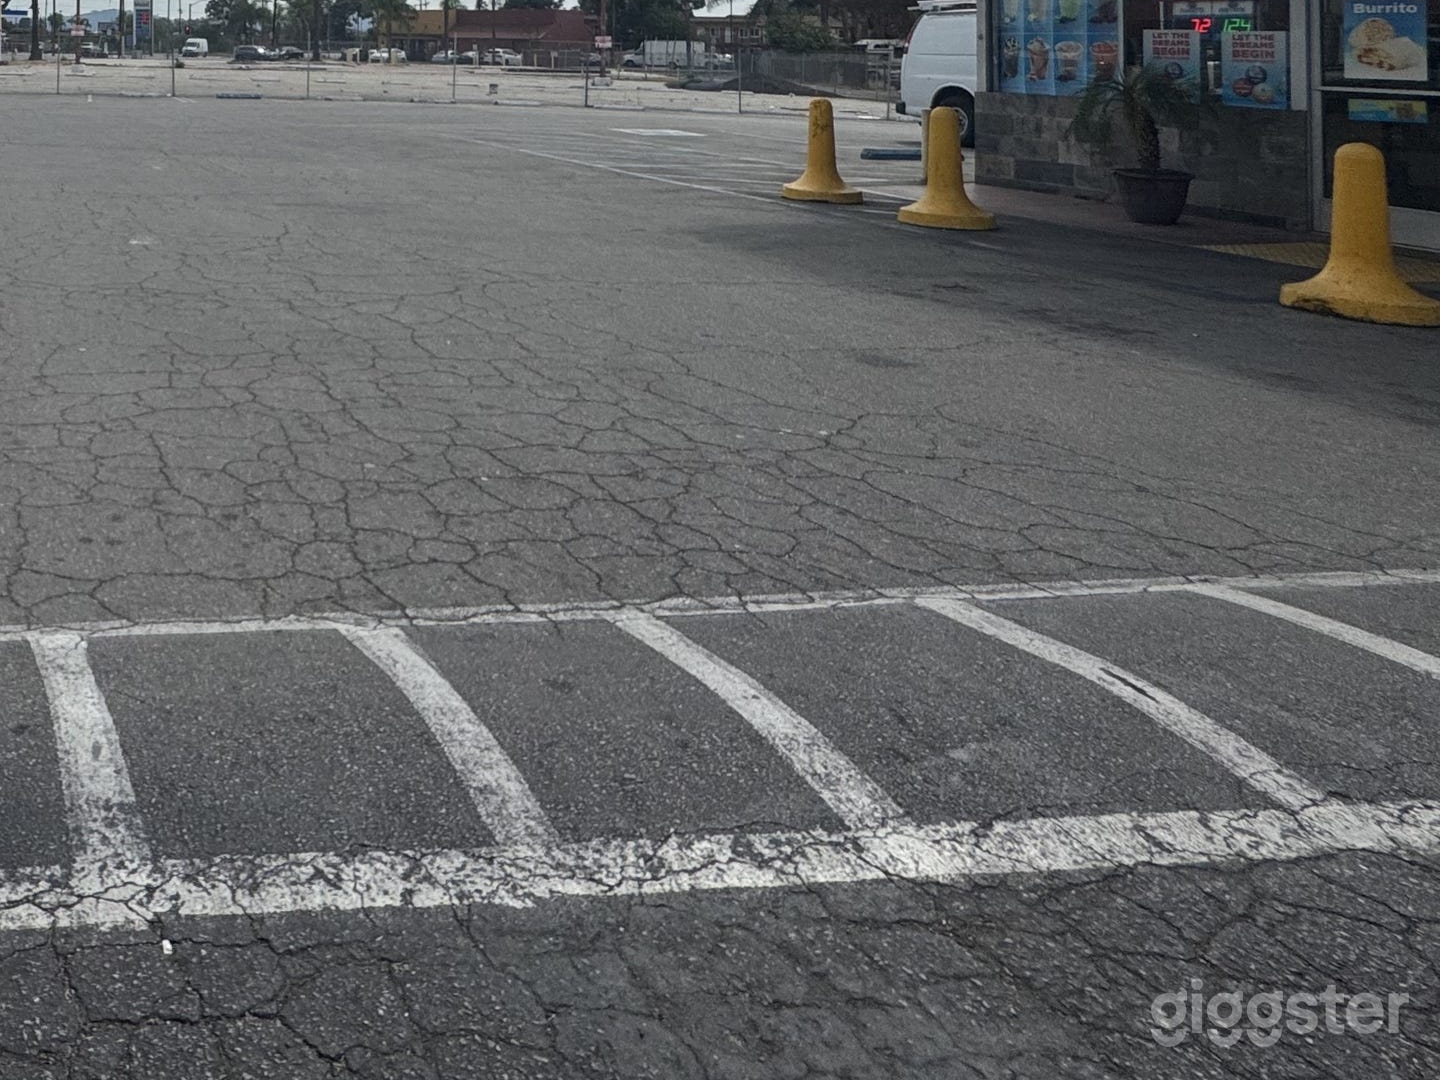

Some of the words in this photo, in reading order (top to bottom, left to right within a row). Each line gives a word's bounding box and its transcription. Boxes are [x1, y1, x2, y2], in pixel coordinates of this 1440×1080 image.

[1353, 2, 1418, 14] Burrito
[1191, 18, 1212, 33] 72
[1224, 18, 1251, 32] 124
[1152, 39, 1190, 47] DREAMS
[1232, 41, 1275, 49] DREAMS
[1152, 47, 1190, 56] BEGIN
[1232, 49, 1275, 58] BEGIN
